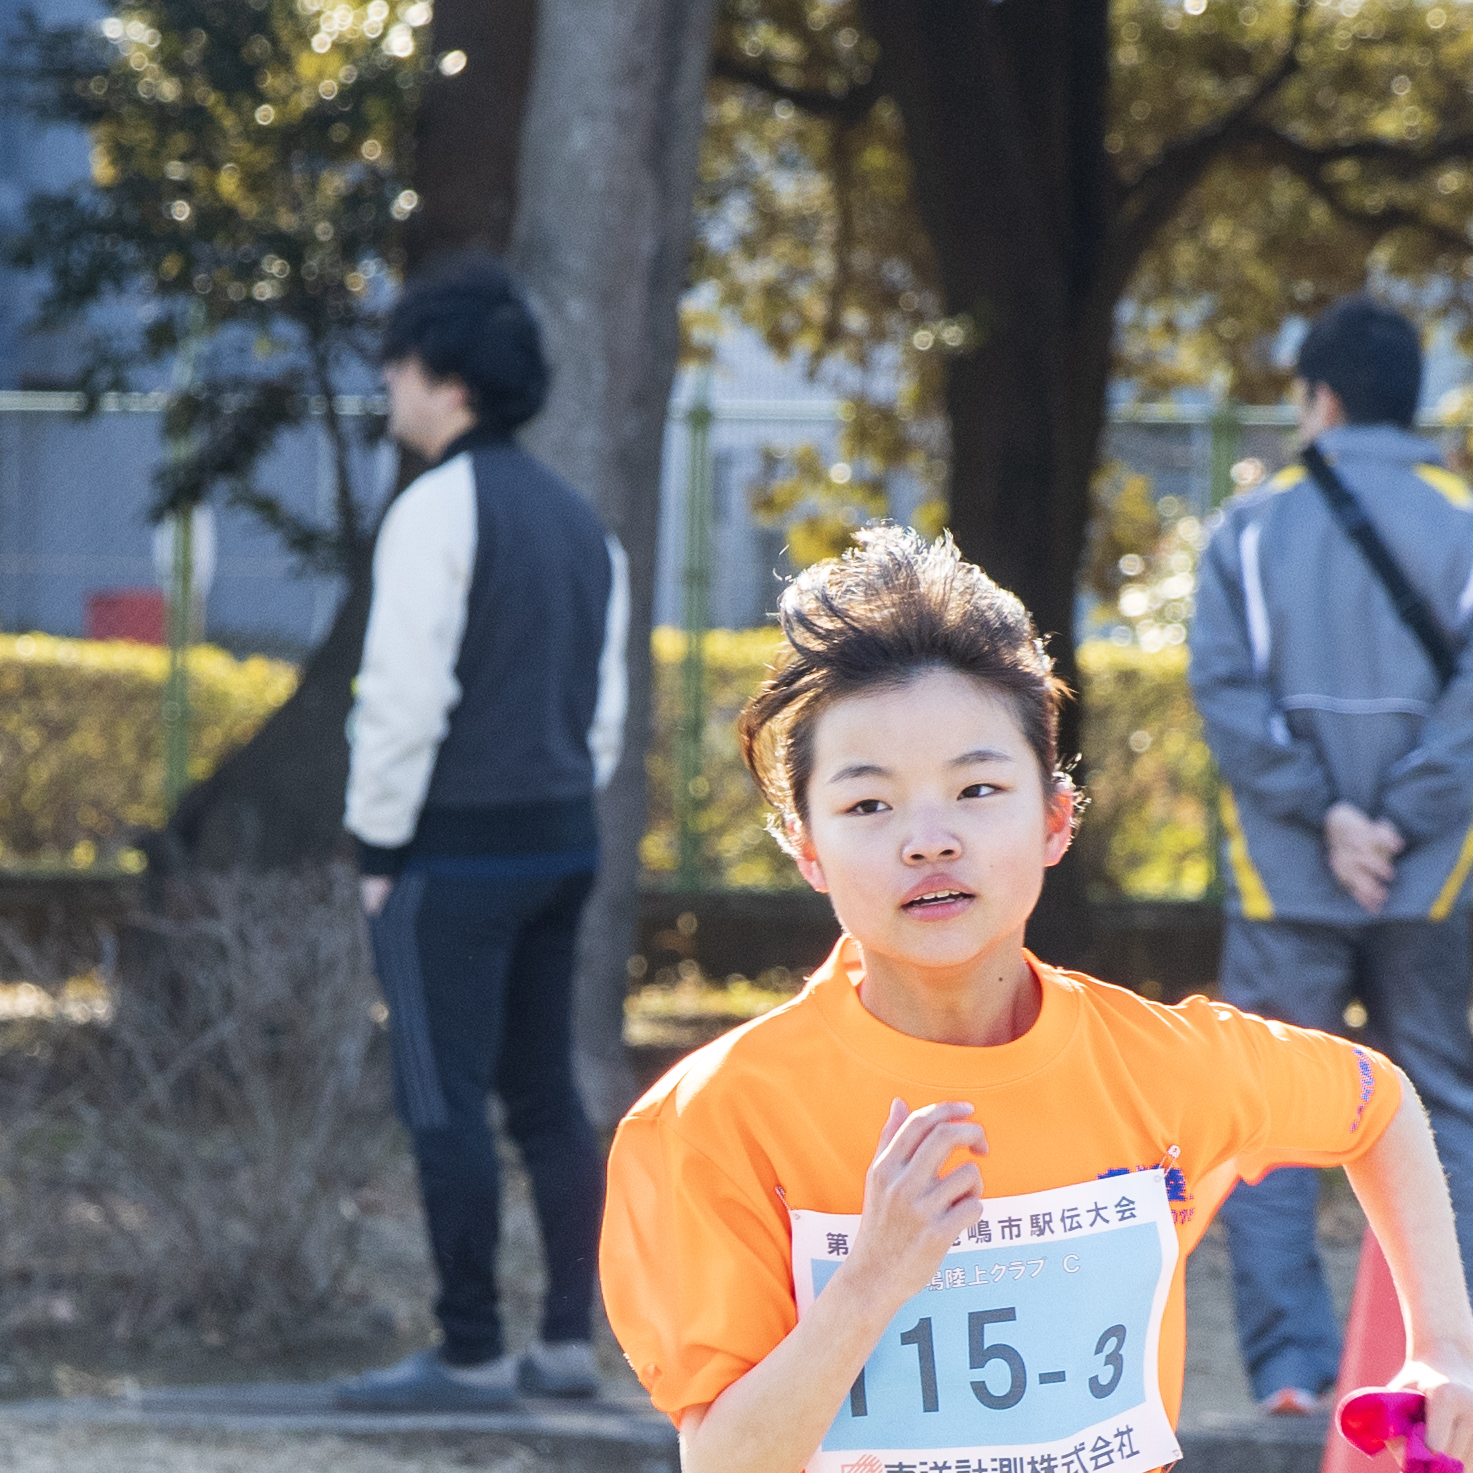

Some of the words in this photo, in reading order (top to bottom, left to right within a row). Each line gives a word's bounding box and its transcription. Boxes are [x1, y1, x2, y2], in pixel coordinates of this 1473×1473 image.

[950, 1195, 1138, 1247] 嶋市駅伝大会
